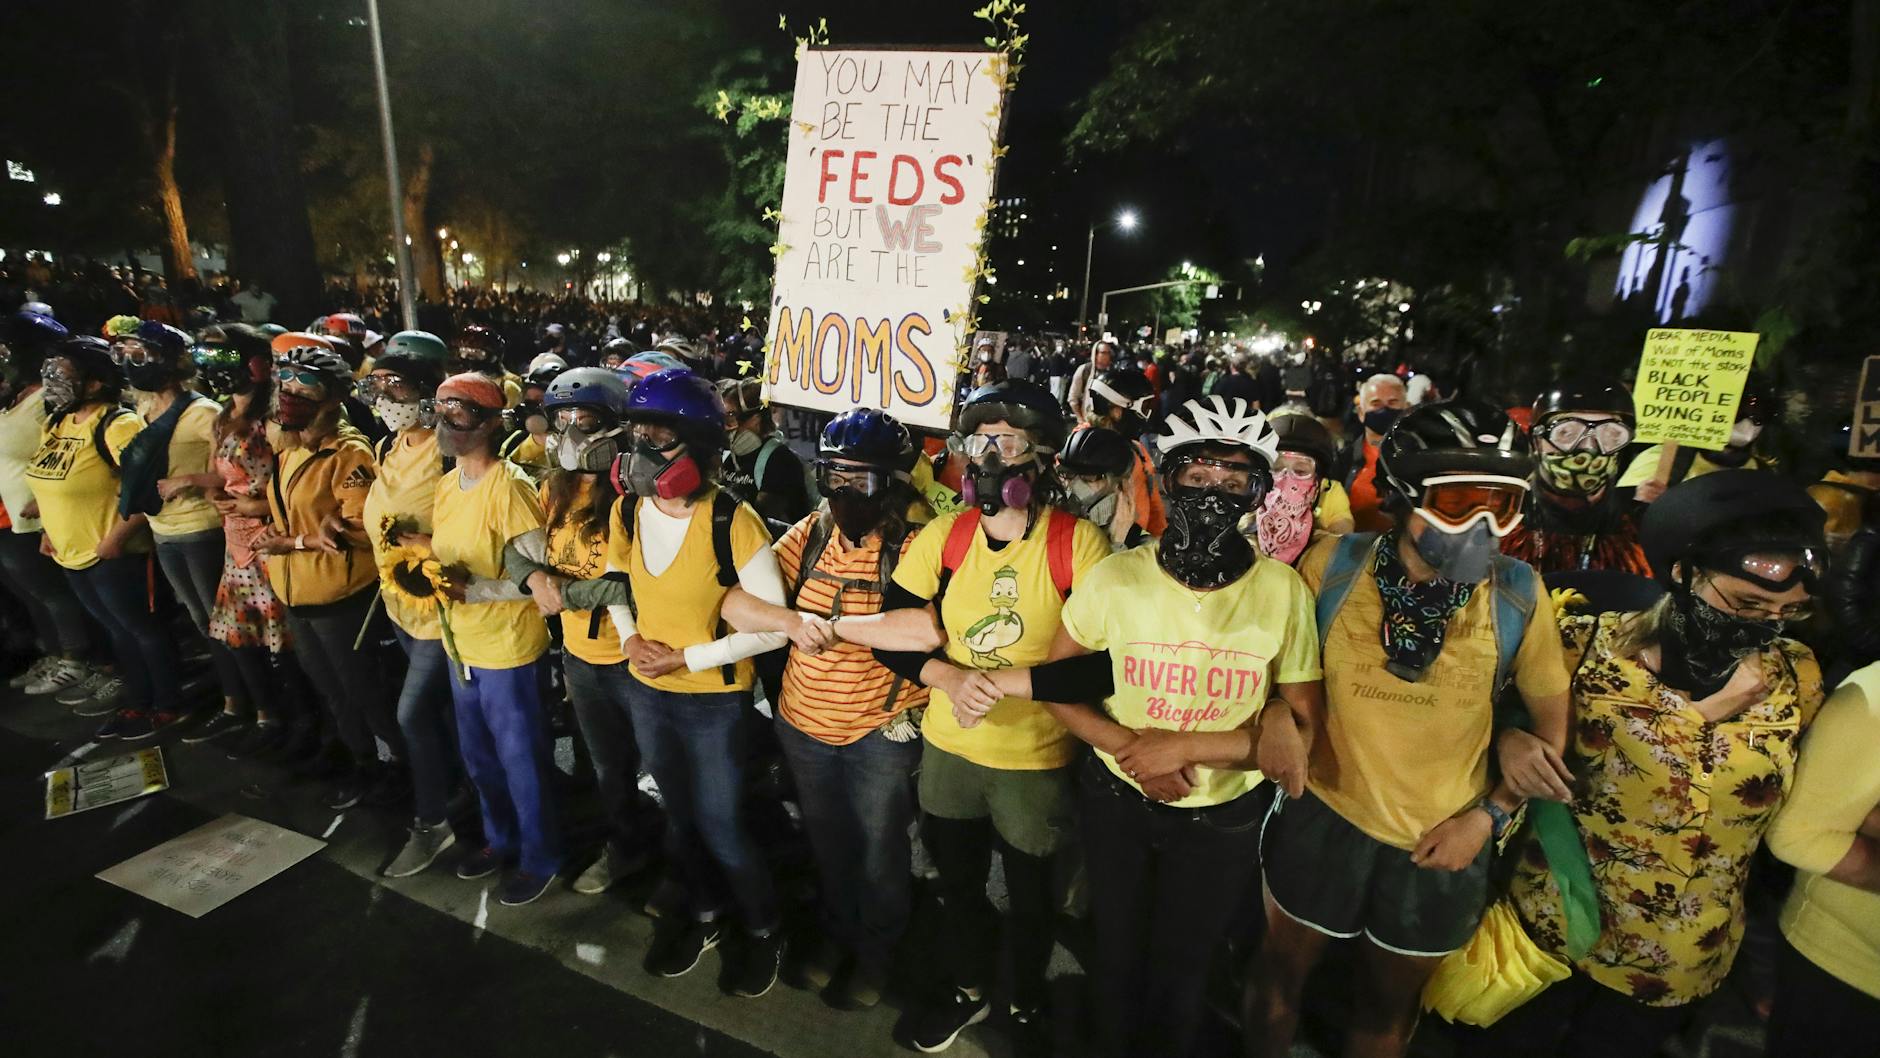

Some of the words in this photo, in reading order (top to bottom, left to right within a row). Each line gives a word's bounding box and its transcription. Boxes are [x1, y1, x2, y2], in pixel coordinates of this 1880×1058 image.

[821, 52, 882, 96] YOU
[904, 59, 982, 104] MAY
[820, 101, 862, 140] BE
[880, 103, 943, 141] THE
[813, 207, 868, 239] BUT
[875, 204, 943, 253] WE
[803, 242, 858, 282] ARE
[870, 250, 929, 287] THE
[1649, 331, 1682, 341] DEAR
[1690, 332, 1737, 344] MEDIA,
[1661, 359, 1685, 368] NOT
[1686, 346, 1702, 357] of
[1702, 347, 1745, 360] Moms
[1647, 370, 1710, 388] BLACK
[1655, 387, 1734, 407] PEOPLE
[1642, 404, 1703, 422] DYING
[1124, 655, 1197, 697] RIVER
[1207, 666, 1263, 701] CITY
[1350, 682, 1440, 708] Tillamook
[1146, 696, 1230, 732] Bicycles
